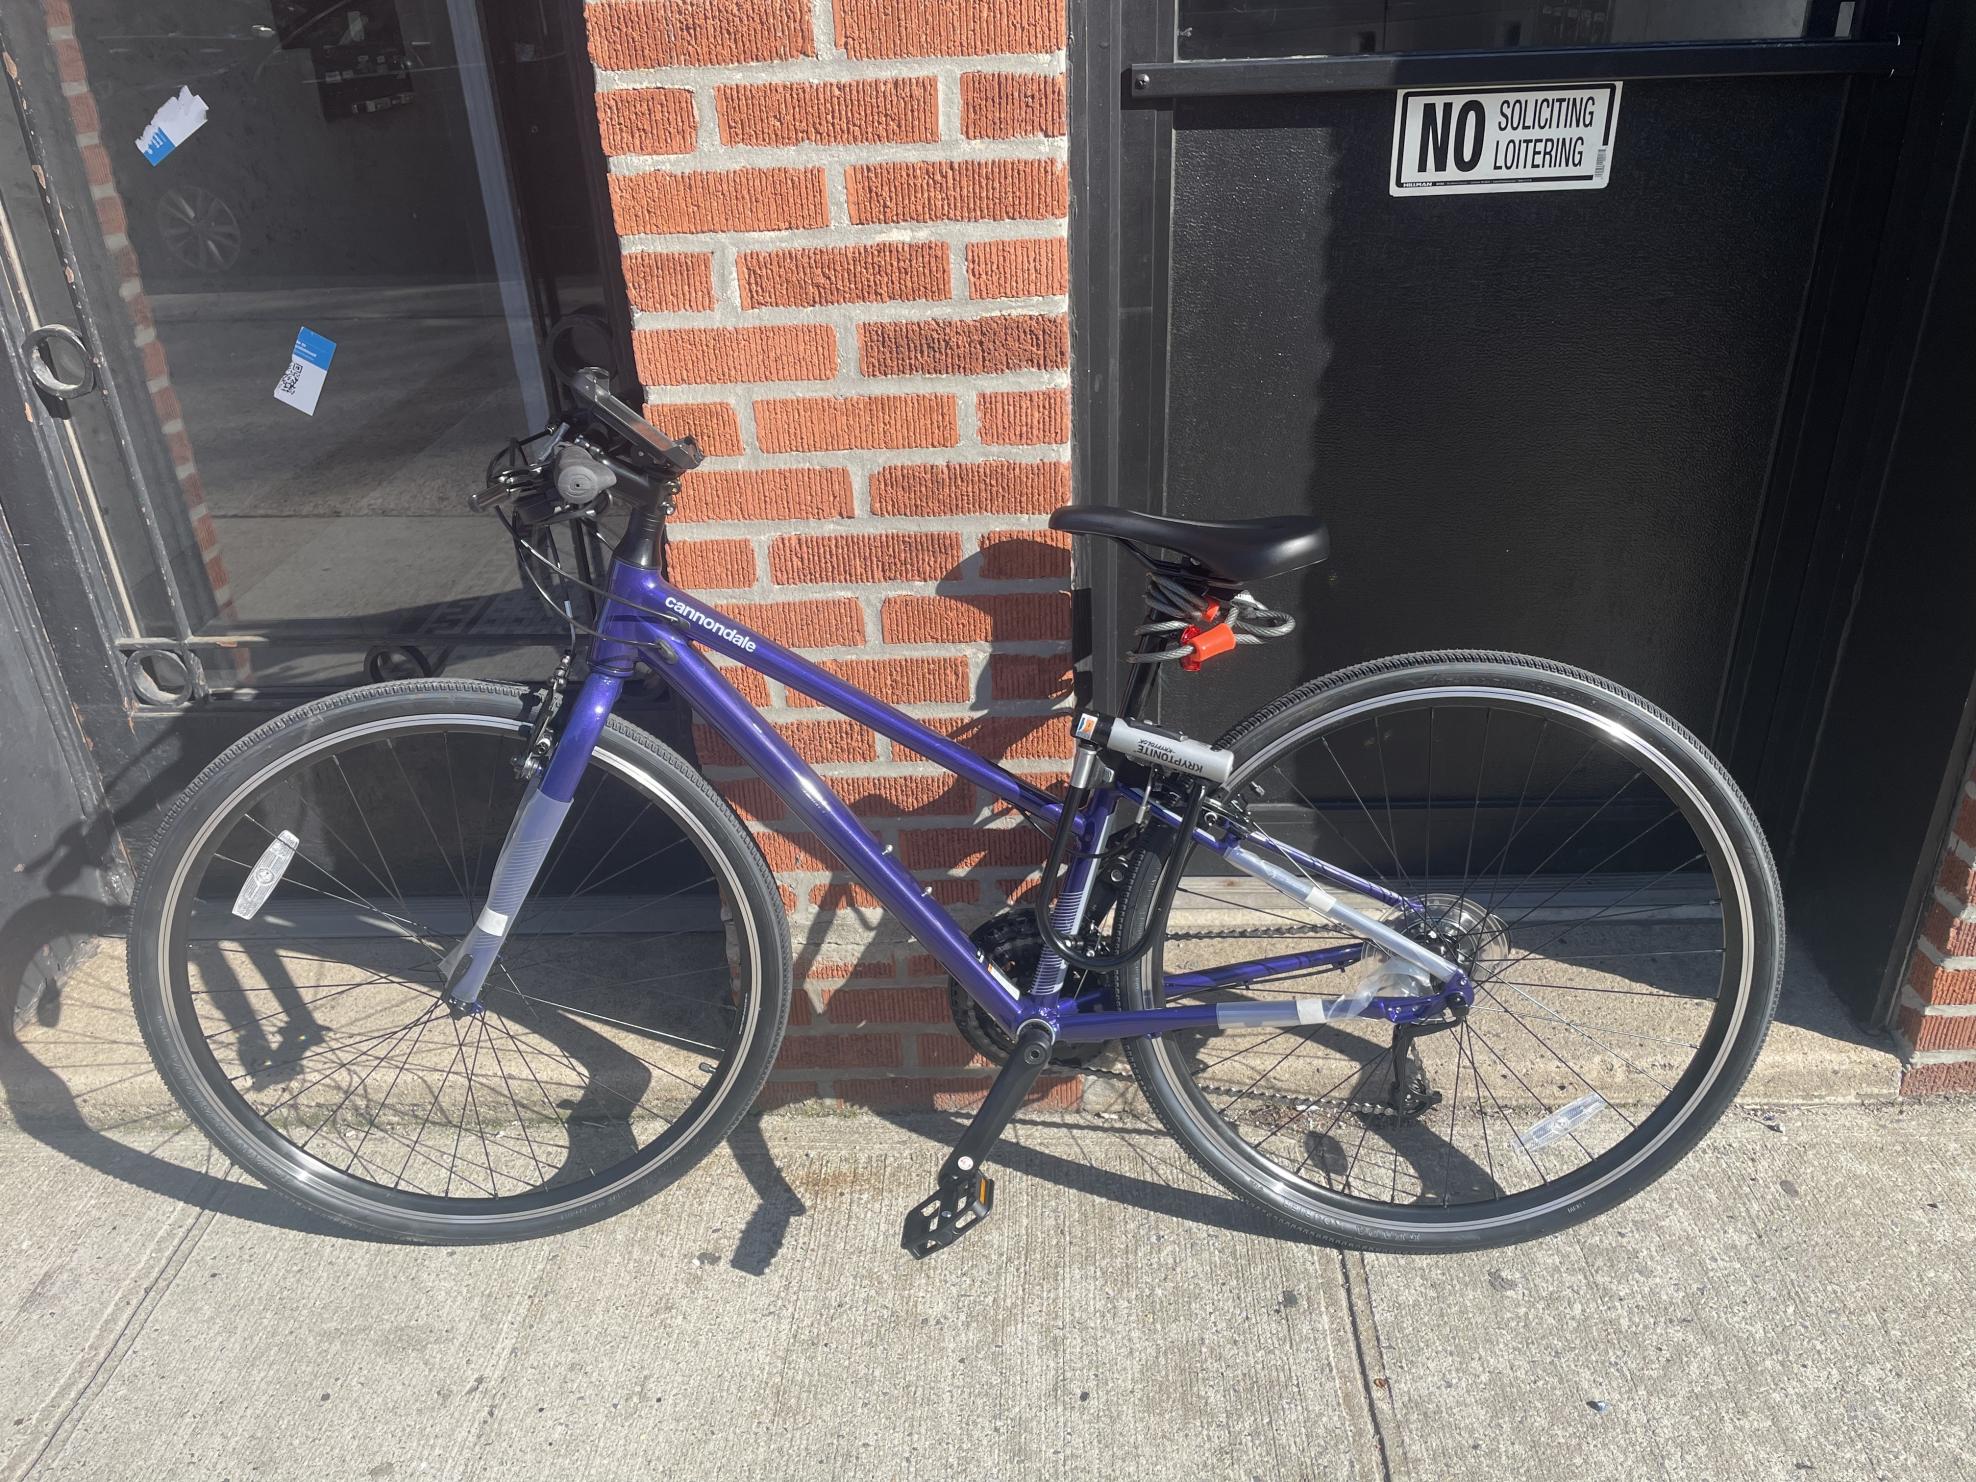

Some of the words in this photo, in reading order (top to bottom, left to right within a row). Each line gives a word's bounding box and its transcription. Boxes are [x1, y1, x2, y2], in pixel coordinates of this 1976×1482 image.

[1498, 95, 1595, 131] SOLICITING
[1417, 99, 1486, 173] NO
[1493, 136, 1585, 171] LOITERING
[665, 596, 757, 653] cannondale
[1137, 744, 1204, 773] KRYPTONITE
